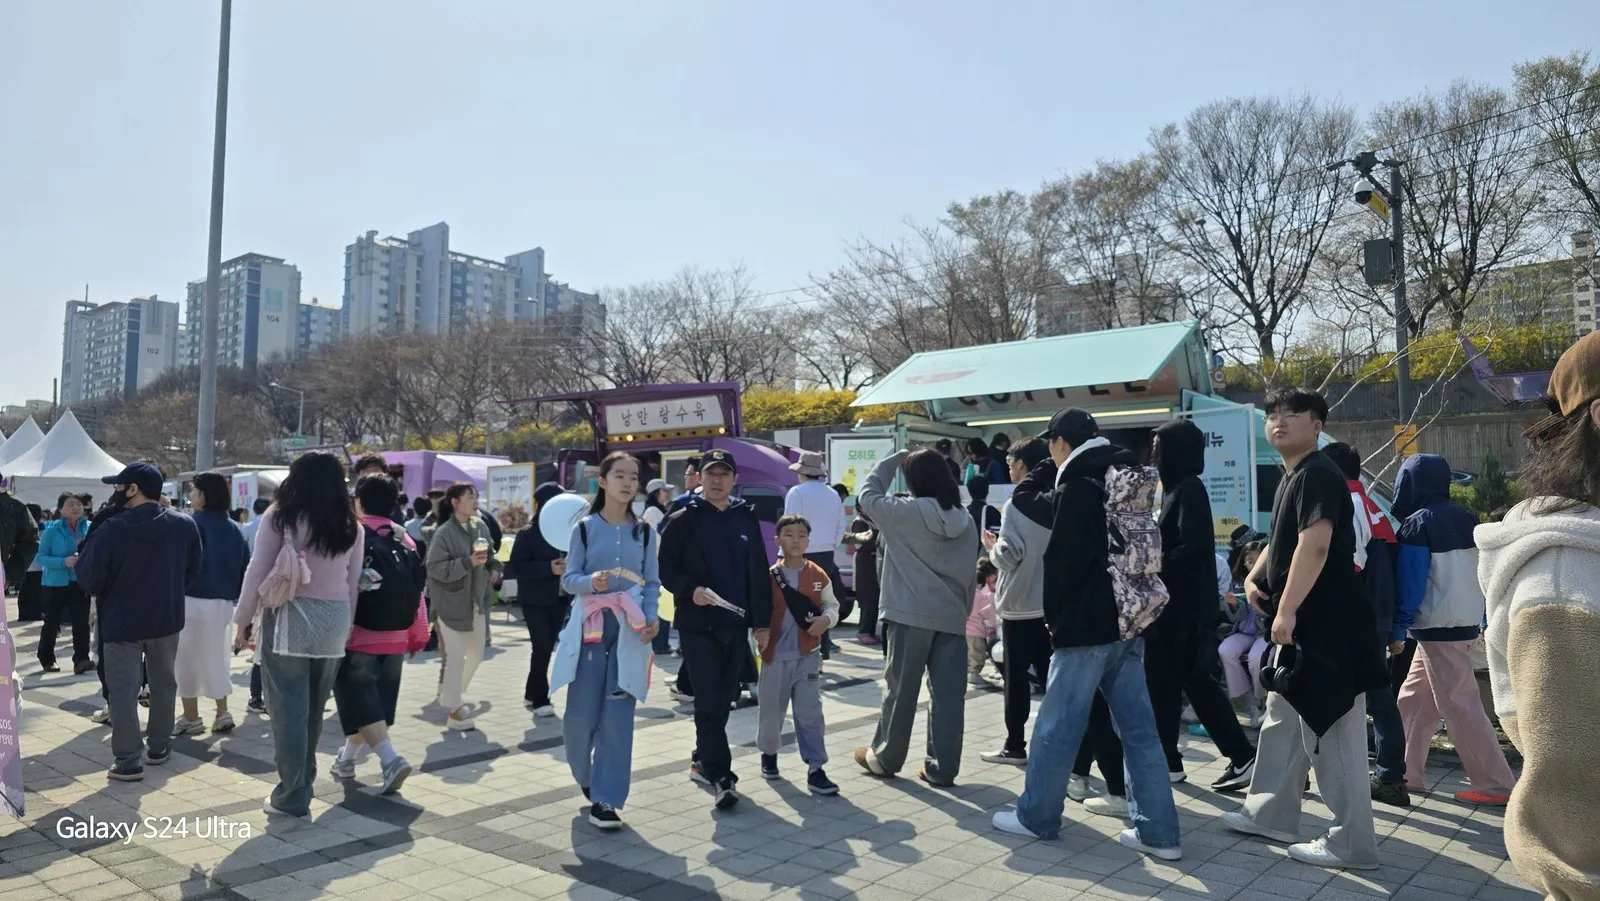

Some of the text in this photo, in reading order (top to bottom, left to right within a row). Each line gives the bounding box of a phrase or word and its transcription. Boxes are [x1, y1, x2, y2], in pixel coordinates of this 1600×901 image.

[266, 314, 280, 323] 104
[146, 347, 159, 355] 102
[621, 407, 648, 427] 낭만
[848, 450, 876, 460] 모히또
[812, 581, 823, 592] E
